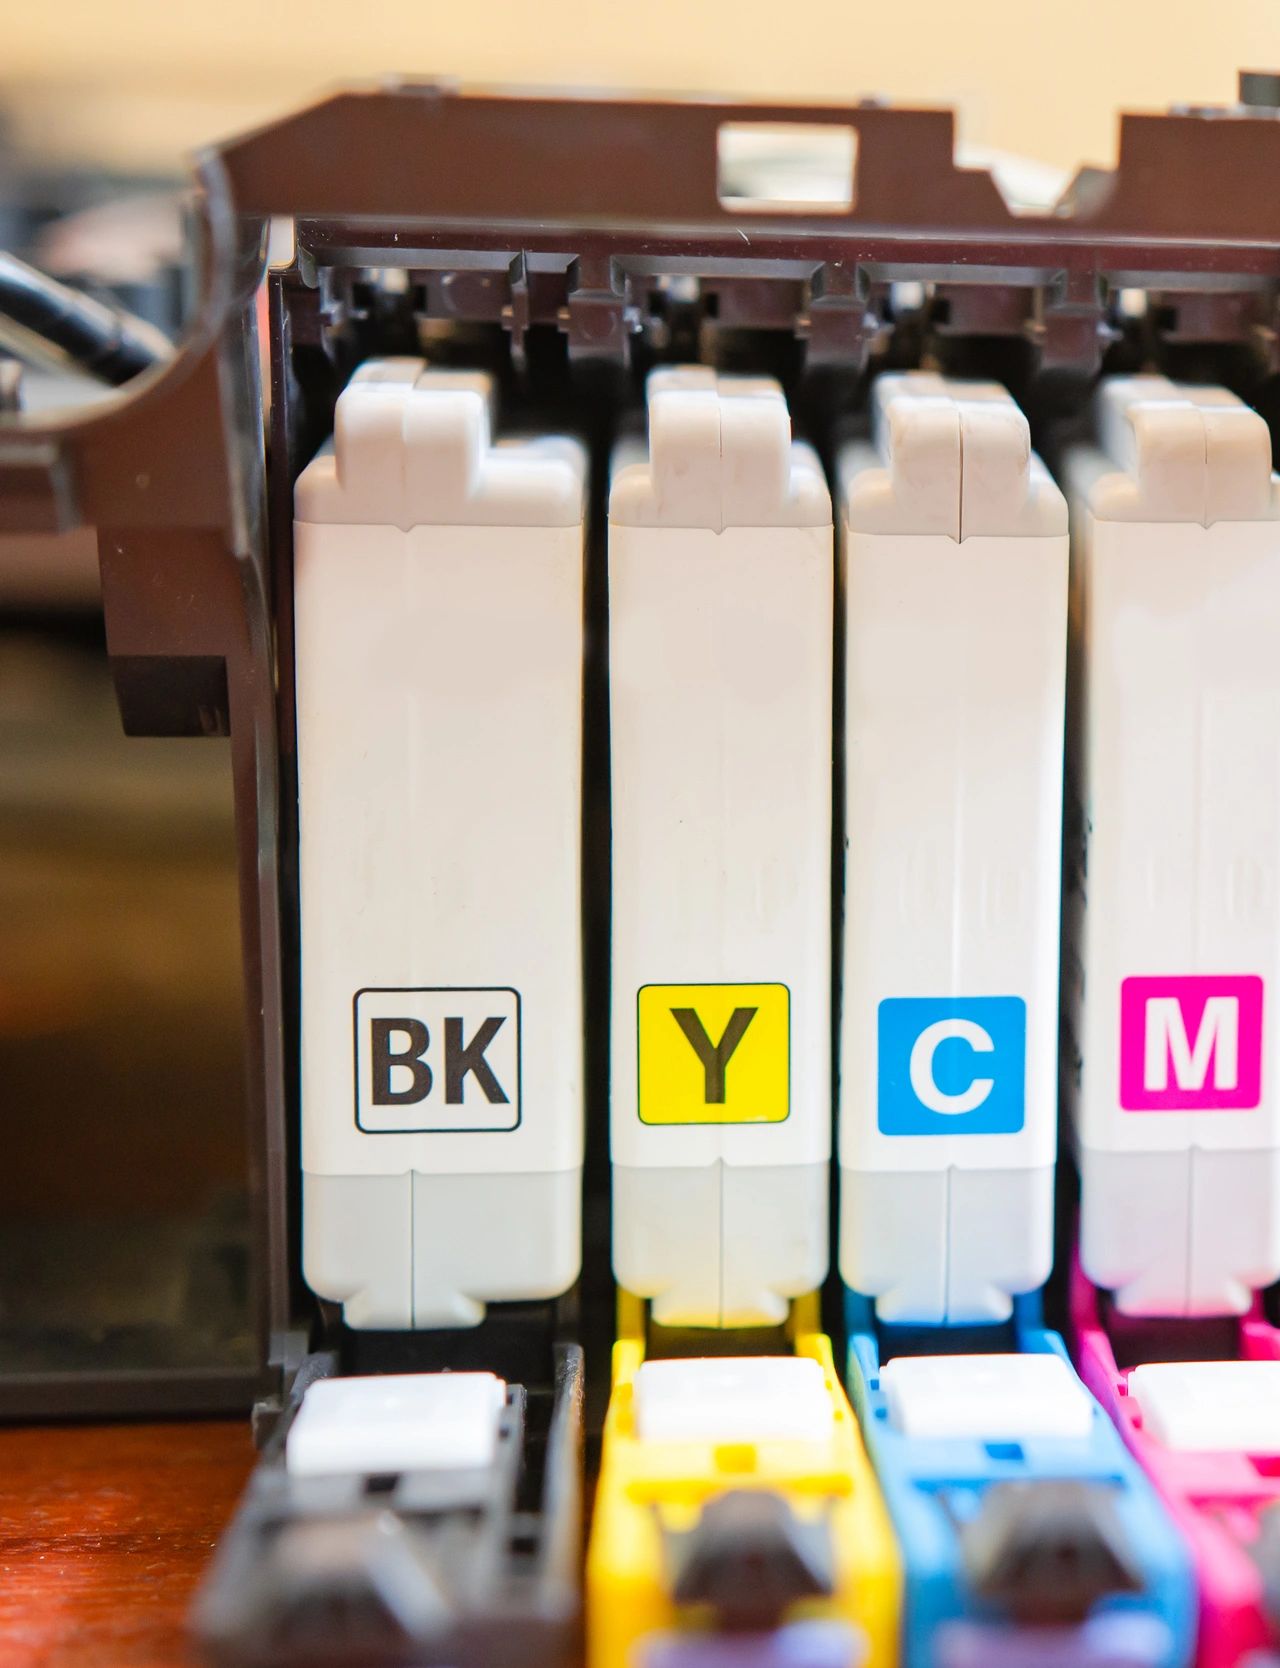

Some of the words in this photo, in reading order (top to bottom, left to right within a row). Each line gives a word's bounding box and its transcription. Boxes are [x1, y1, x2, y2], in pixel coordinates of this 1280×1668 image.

[370, 1016, 510, 1106] BK
[670, 1007, 758, 1104] Y
[910, 1018, 994, 1114] C
[1144, 997, 1239, 1091] M
